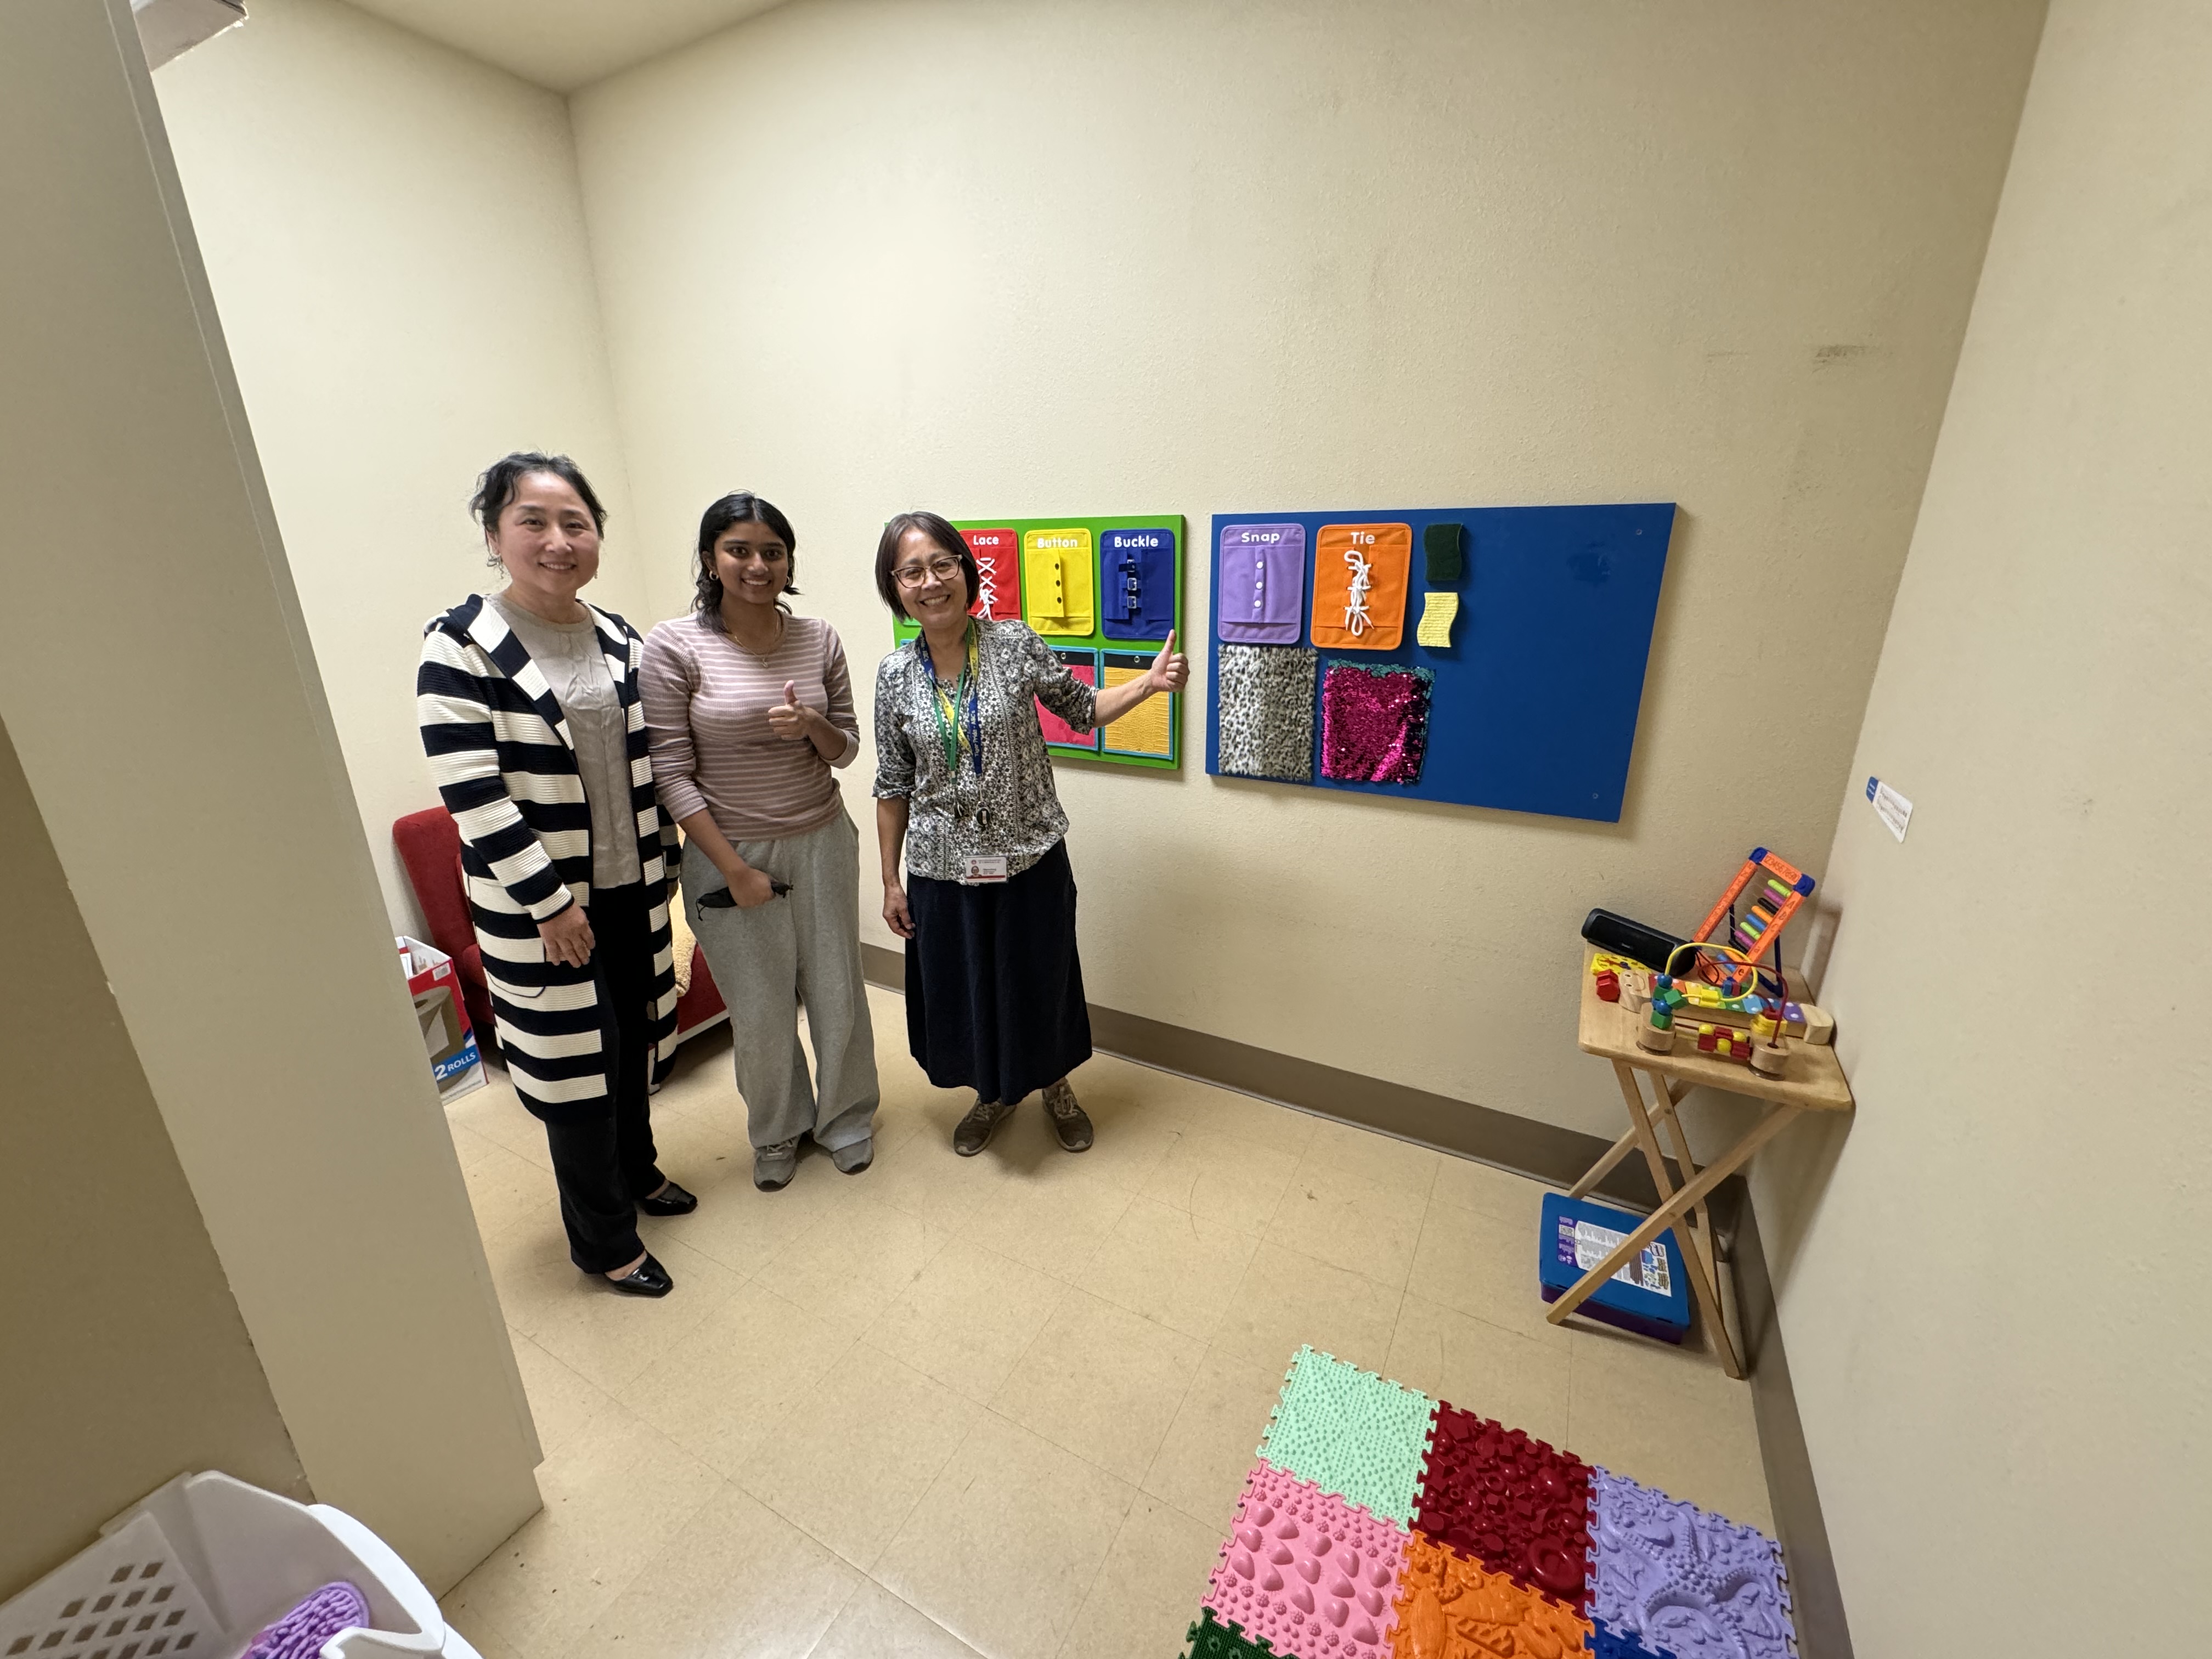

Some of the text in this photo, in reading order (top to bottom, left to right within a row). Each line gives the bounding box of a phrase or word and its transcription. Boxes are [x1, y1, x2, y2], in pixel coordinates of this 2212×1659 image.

[973, 535, 999, 545] Lace
[1037, 538, 1078, 548] Button
[1114, 535, 1159, 548] Buckle
[1241, 532, 1280, 543] Snap
[1351, 532, 1375, 544] Tie
[435, 1052, 476, 1081] 2 ROLLS
